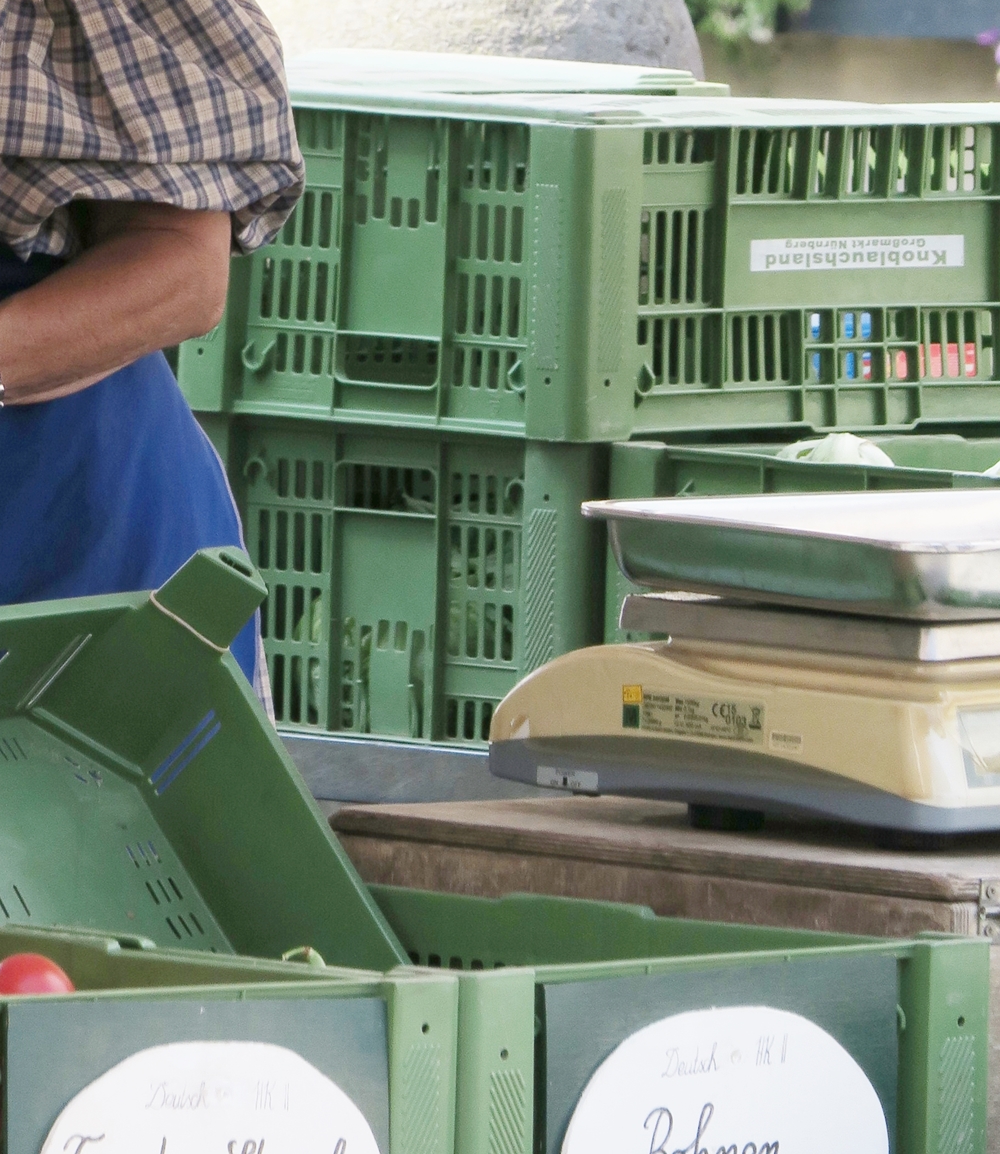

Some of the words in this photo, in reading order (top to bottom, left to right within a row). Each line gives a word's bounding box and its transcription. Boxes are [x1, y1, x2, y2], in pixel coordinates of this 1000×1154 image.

[785, 238, 847, 250] Nürnberg
[852, 237, 926, 250] Großmarkt
[765, 249, 947, 269] Knoblauchsland
[660, 1041, 719, 1078] Deutsch
